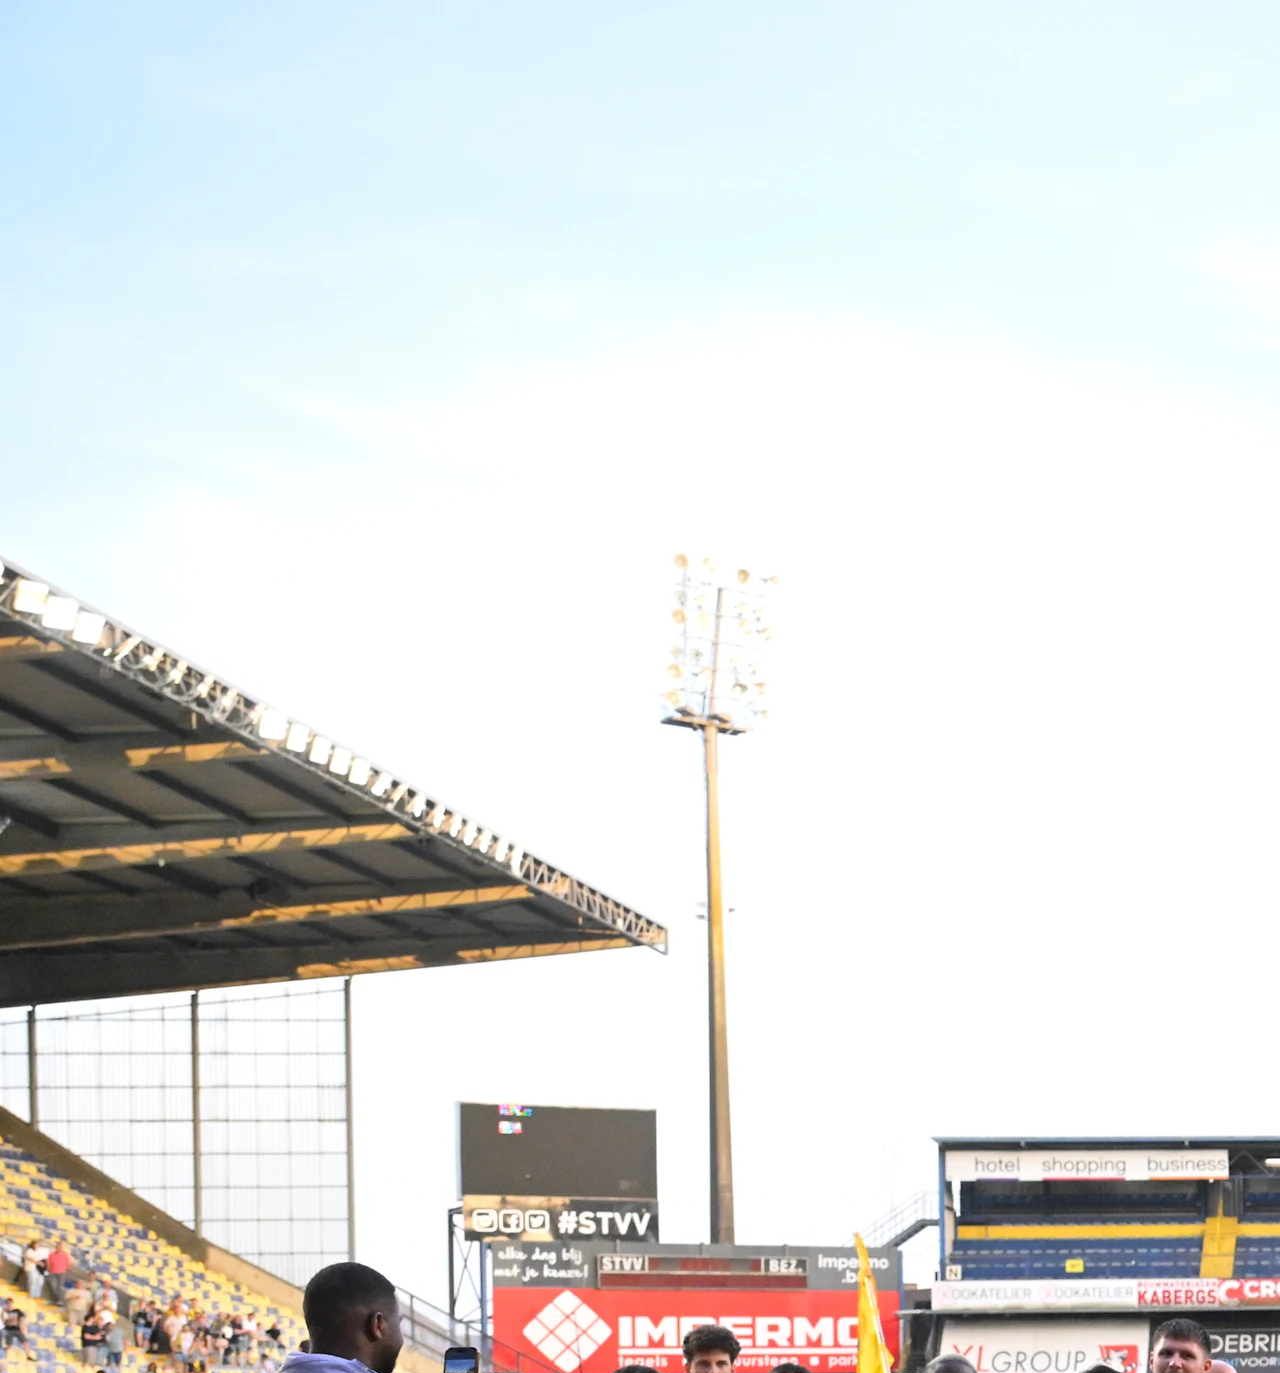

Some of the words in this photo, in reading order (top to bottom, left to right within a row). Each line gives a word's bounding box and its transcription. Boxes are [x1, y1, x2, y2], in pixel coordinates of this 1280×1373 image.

[974, 1156, 1020, 1173] hotel
[1042, 1156, 1127, 1177] shopping
[1147, 1155, 1228, 1172] business
[558, 1210, 651, 1236] #STVV
[602, 1256, 644, 1270] STVV
[769, 1259, 803, 1273] BEZ.
[818, 1253, 890, 1272] impemo
[948, 1268, 959, 1279] N
[1137, 1289, 1217, 1305] KABERGS
[618, 1355, 668, 1368] tegels
